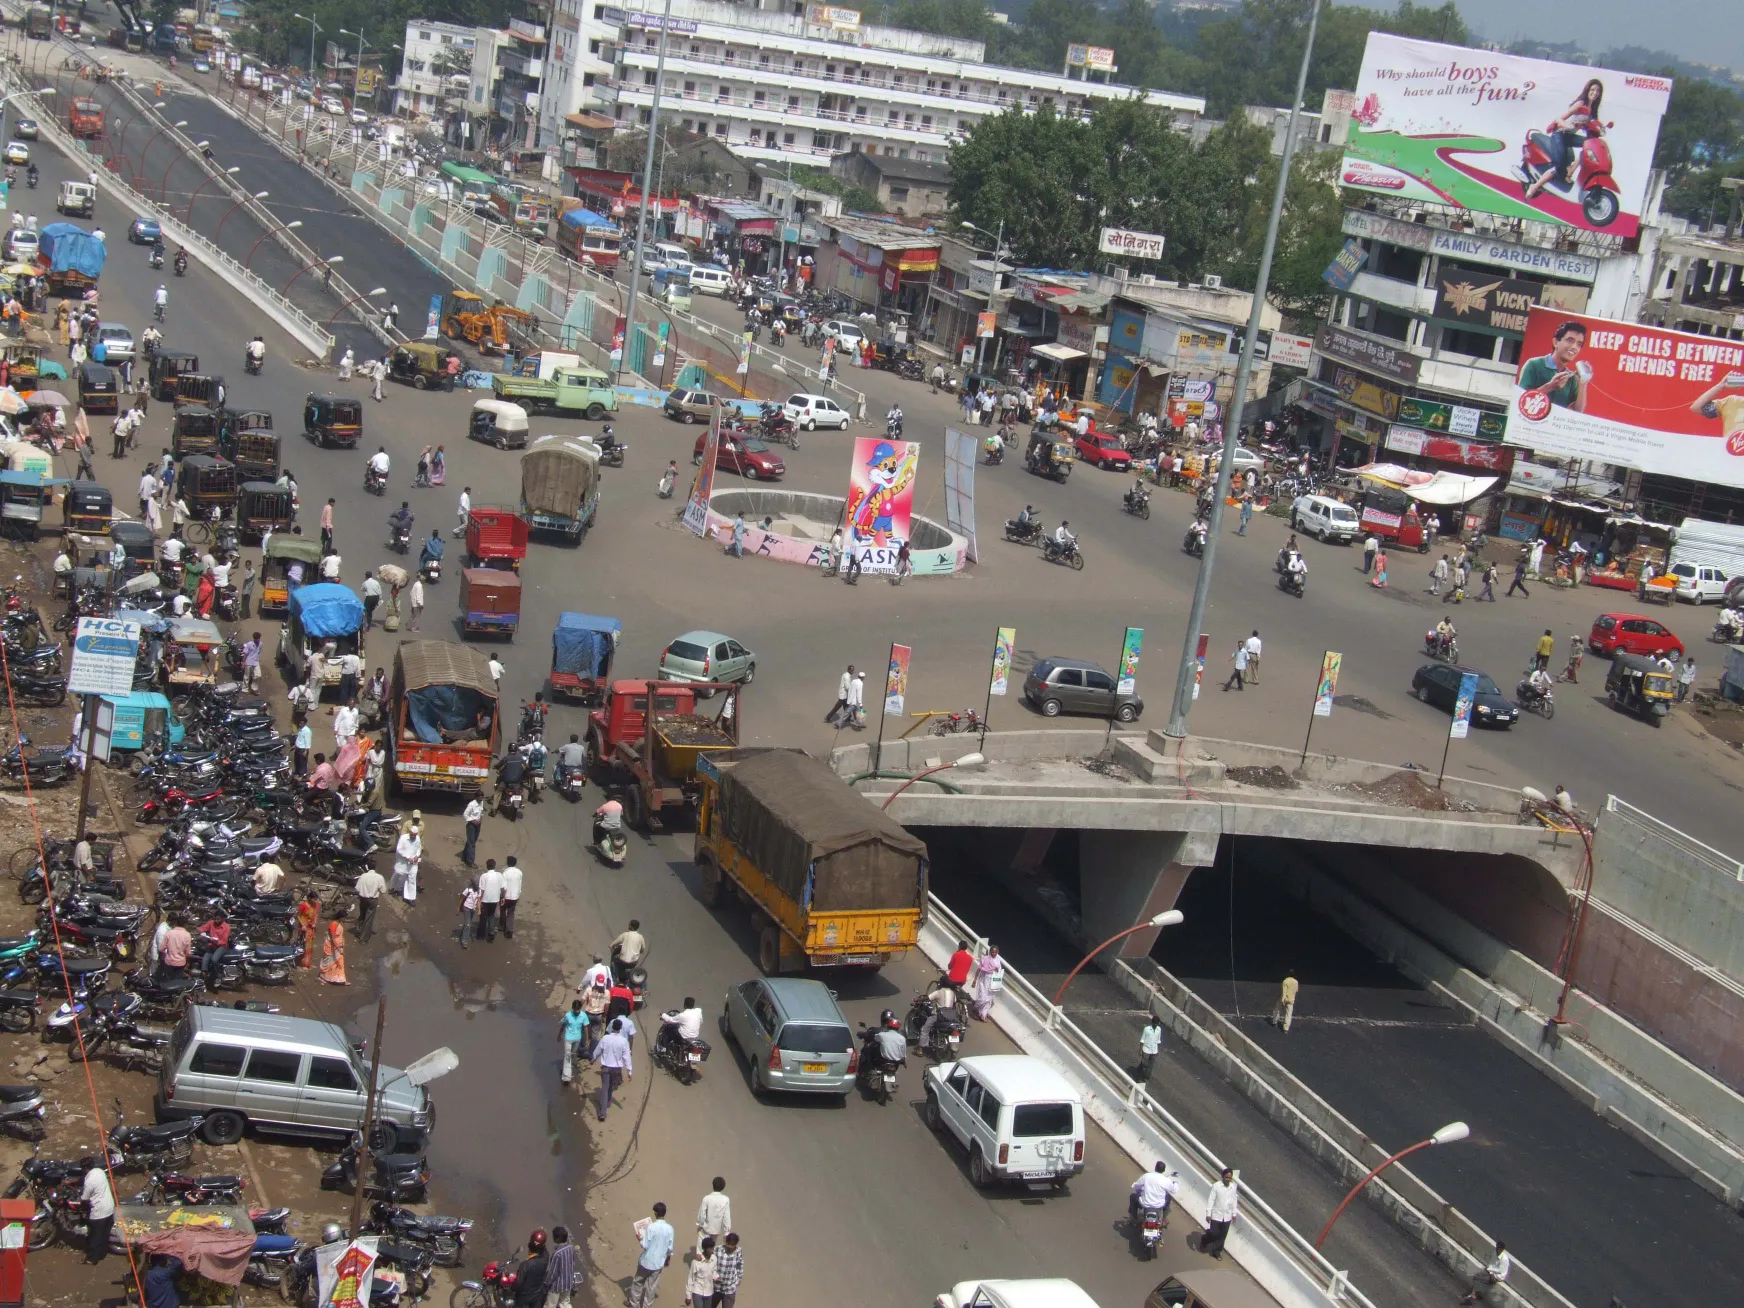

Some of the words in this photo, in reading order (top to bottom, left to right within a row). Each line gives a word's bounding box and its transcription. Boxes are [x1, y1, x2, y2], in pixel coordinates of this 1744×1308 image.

[1376, 69, 1402, 81] Why
[1405, 66, 1447, 79] should
[1448, 62, 1499, 84] boys
[1404, 87, 1434, 96] have
[1437, 86, 1453, 95] all
[1456, 84, 1475, 94] the
[1472, 81, 1536, 106] fun?
[1634, 82, 1669, 92] HONDA
[1351, 173, 1400, 184] Pleasure
[1108, 231, 1161, 251] सोनिगरा
[1344, 214, 1368, 230] HOTEL
[1434, 235, 1482, 256] FAMILY
[1490, 246, 1550, 268] GARDEN
[1336, 249, 1360, 272] DARYA
[1496, 290, 1536, 310] VICKY
[1590, 331, 1624, 350] KEEP
[1628, 335, 1672, 357] CALLS
[1676, 342, 1743, 366] BETWEEN
[1618, 354, 1676, 377] FRIENDS
[1680, 363, 1714, 382] FREE
[1731, 432, 1744, 452] Vir
[690, 505, 705, 526] ASM
[83, 620, 136, 633] HCL
